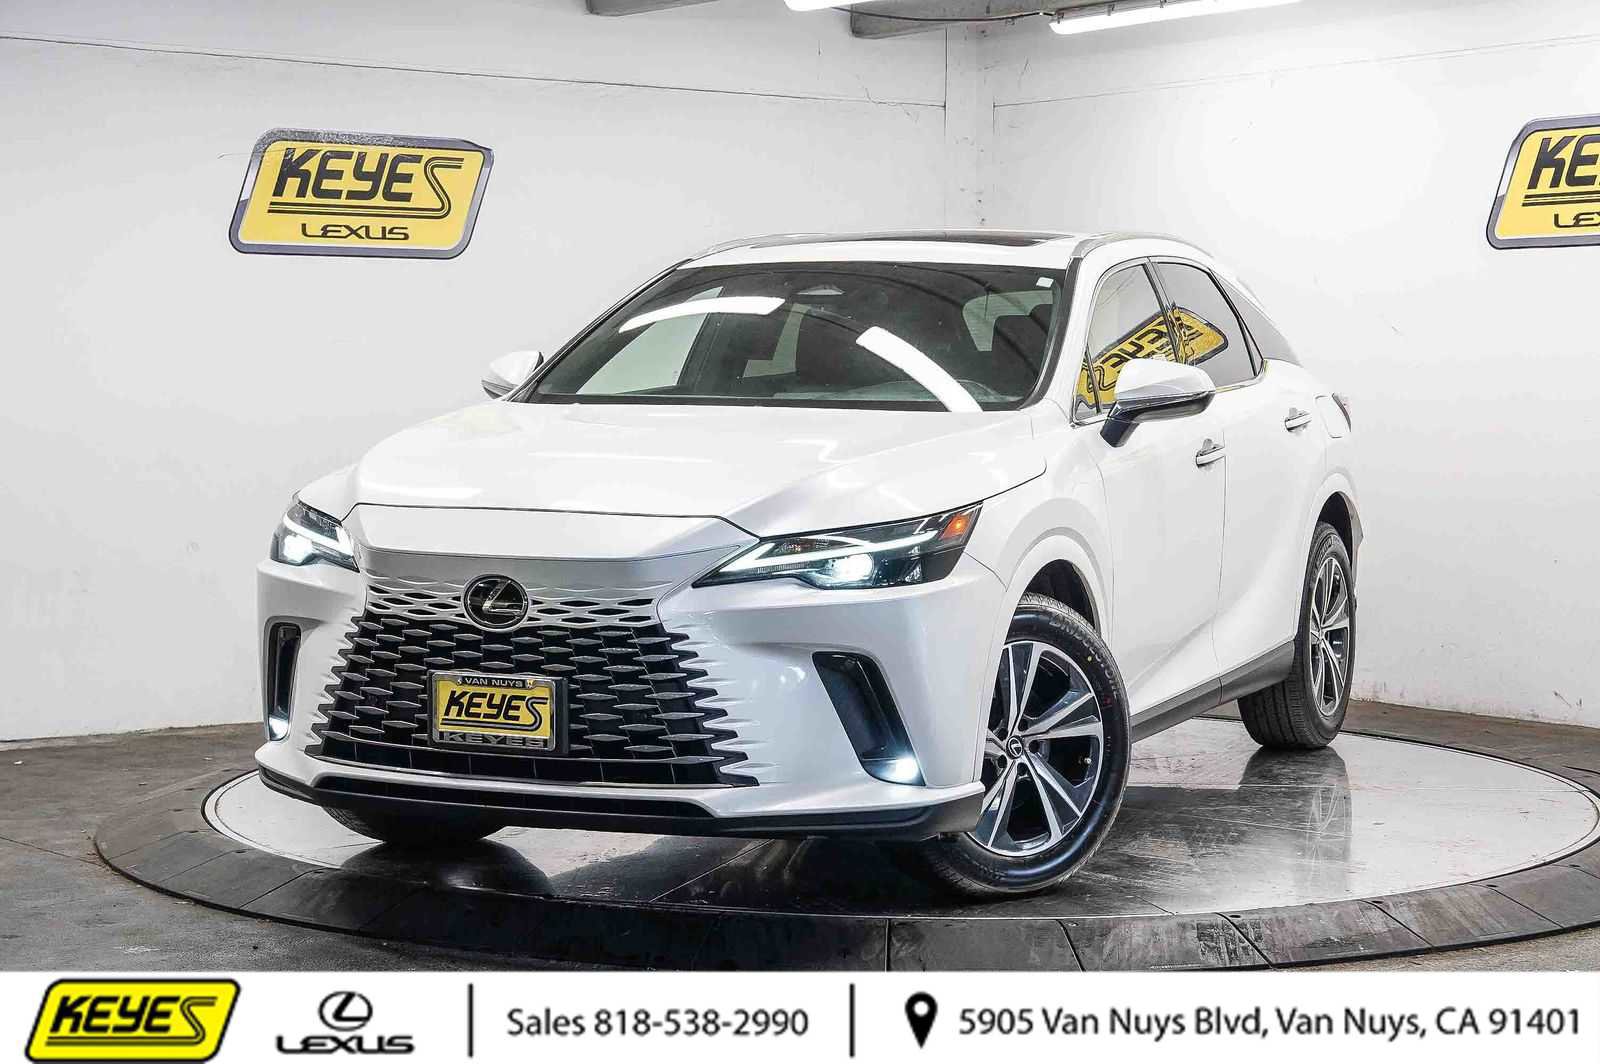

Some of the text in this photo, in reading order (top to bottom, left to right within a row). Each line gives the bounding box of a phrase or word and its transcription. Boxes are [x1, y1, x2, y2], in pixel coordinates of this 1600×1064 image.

[1526, 133, 1600, 190] KE
[268, 147, 465, 219] KEYES
[301, 223, 409, 241] LEXUS
[464, 677, 524, 688] VAN NUYS
[440, 690, 549, 732] KEYES
[444, 732, 545, 748] KEYES
